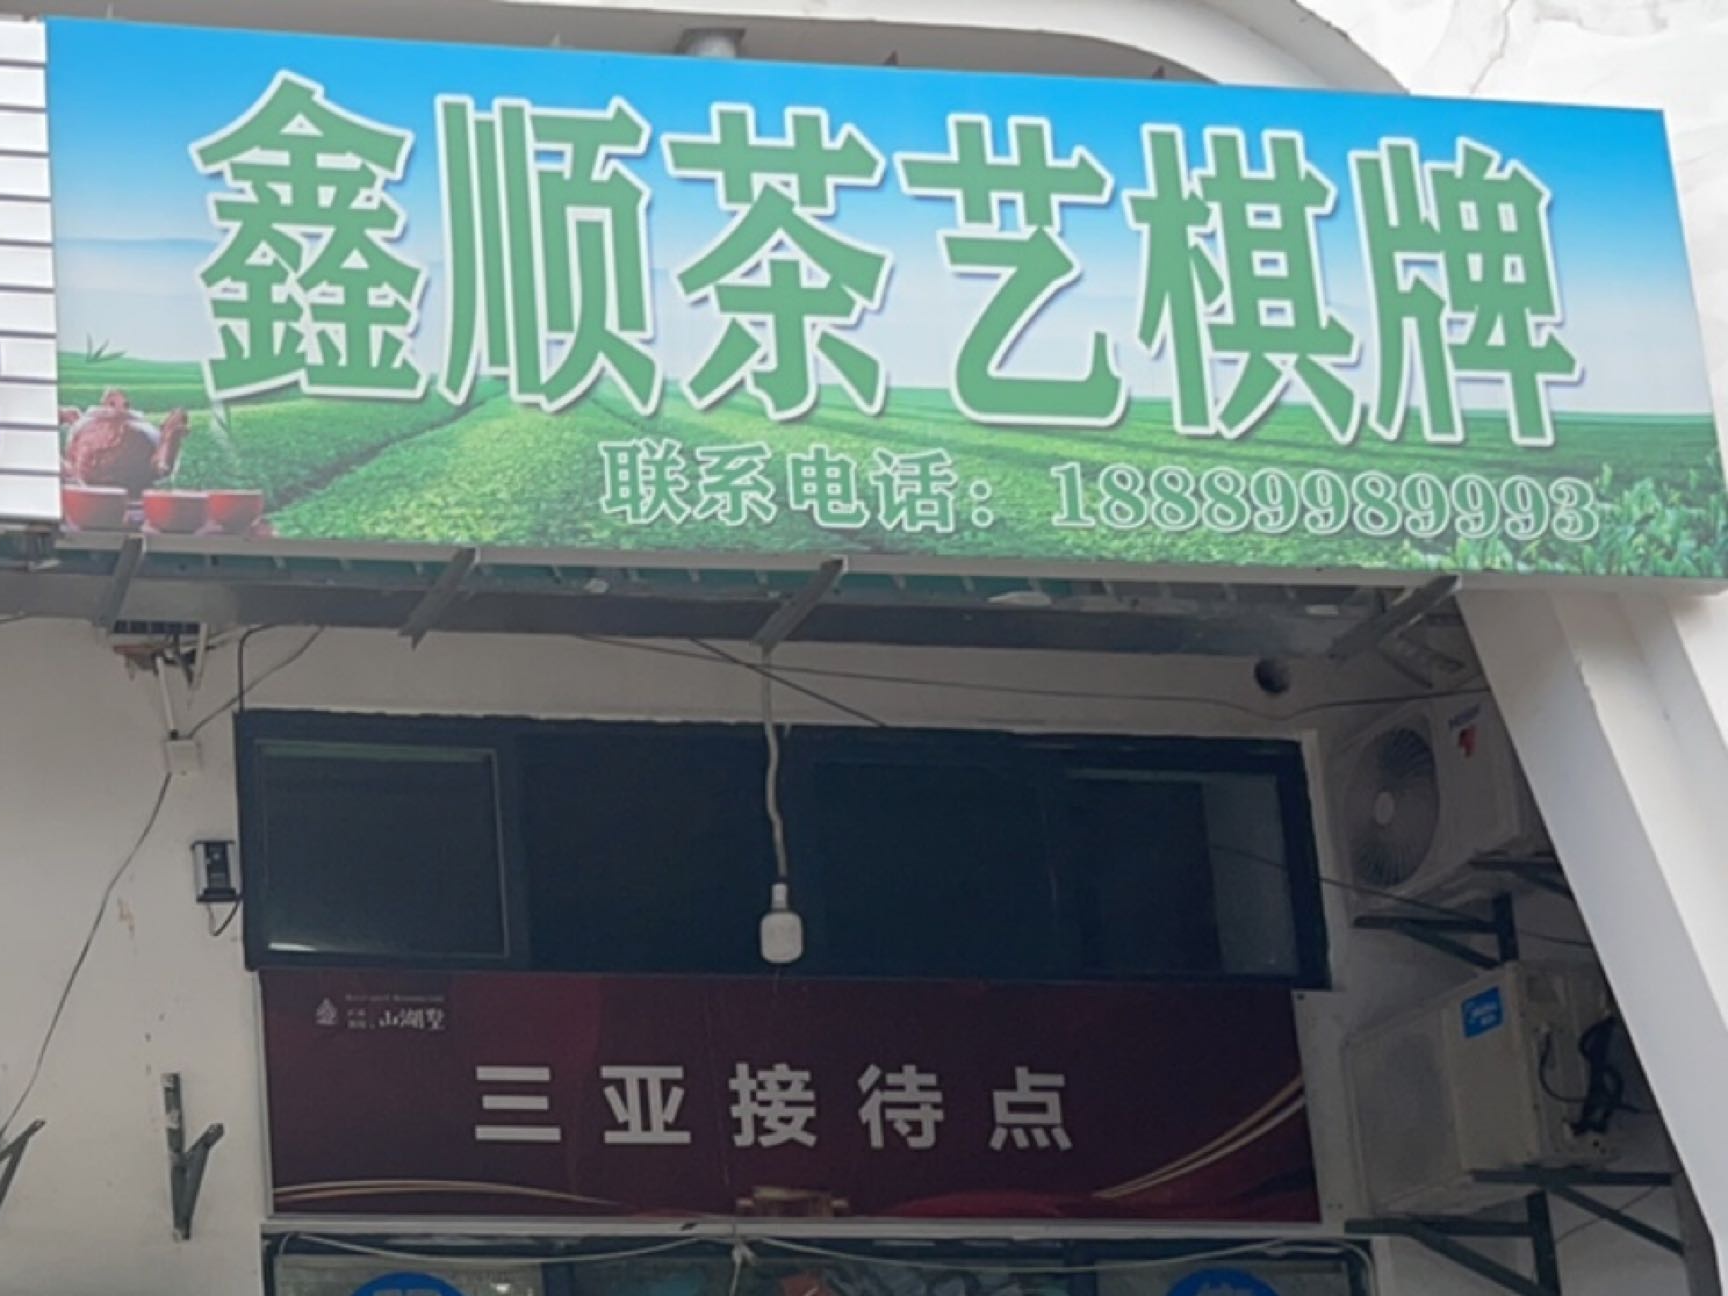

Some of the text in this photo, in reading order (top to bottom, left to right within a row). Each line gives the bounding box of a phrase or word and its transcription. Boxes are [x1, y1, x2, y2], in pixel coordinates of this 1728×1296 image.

[189, 70, 1584, 448] 鑫顺茶艺棋牌
[1048, 460, 1602, 542] 18889989993
[475, 1062, 1073, 1152] 三亚接待点
